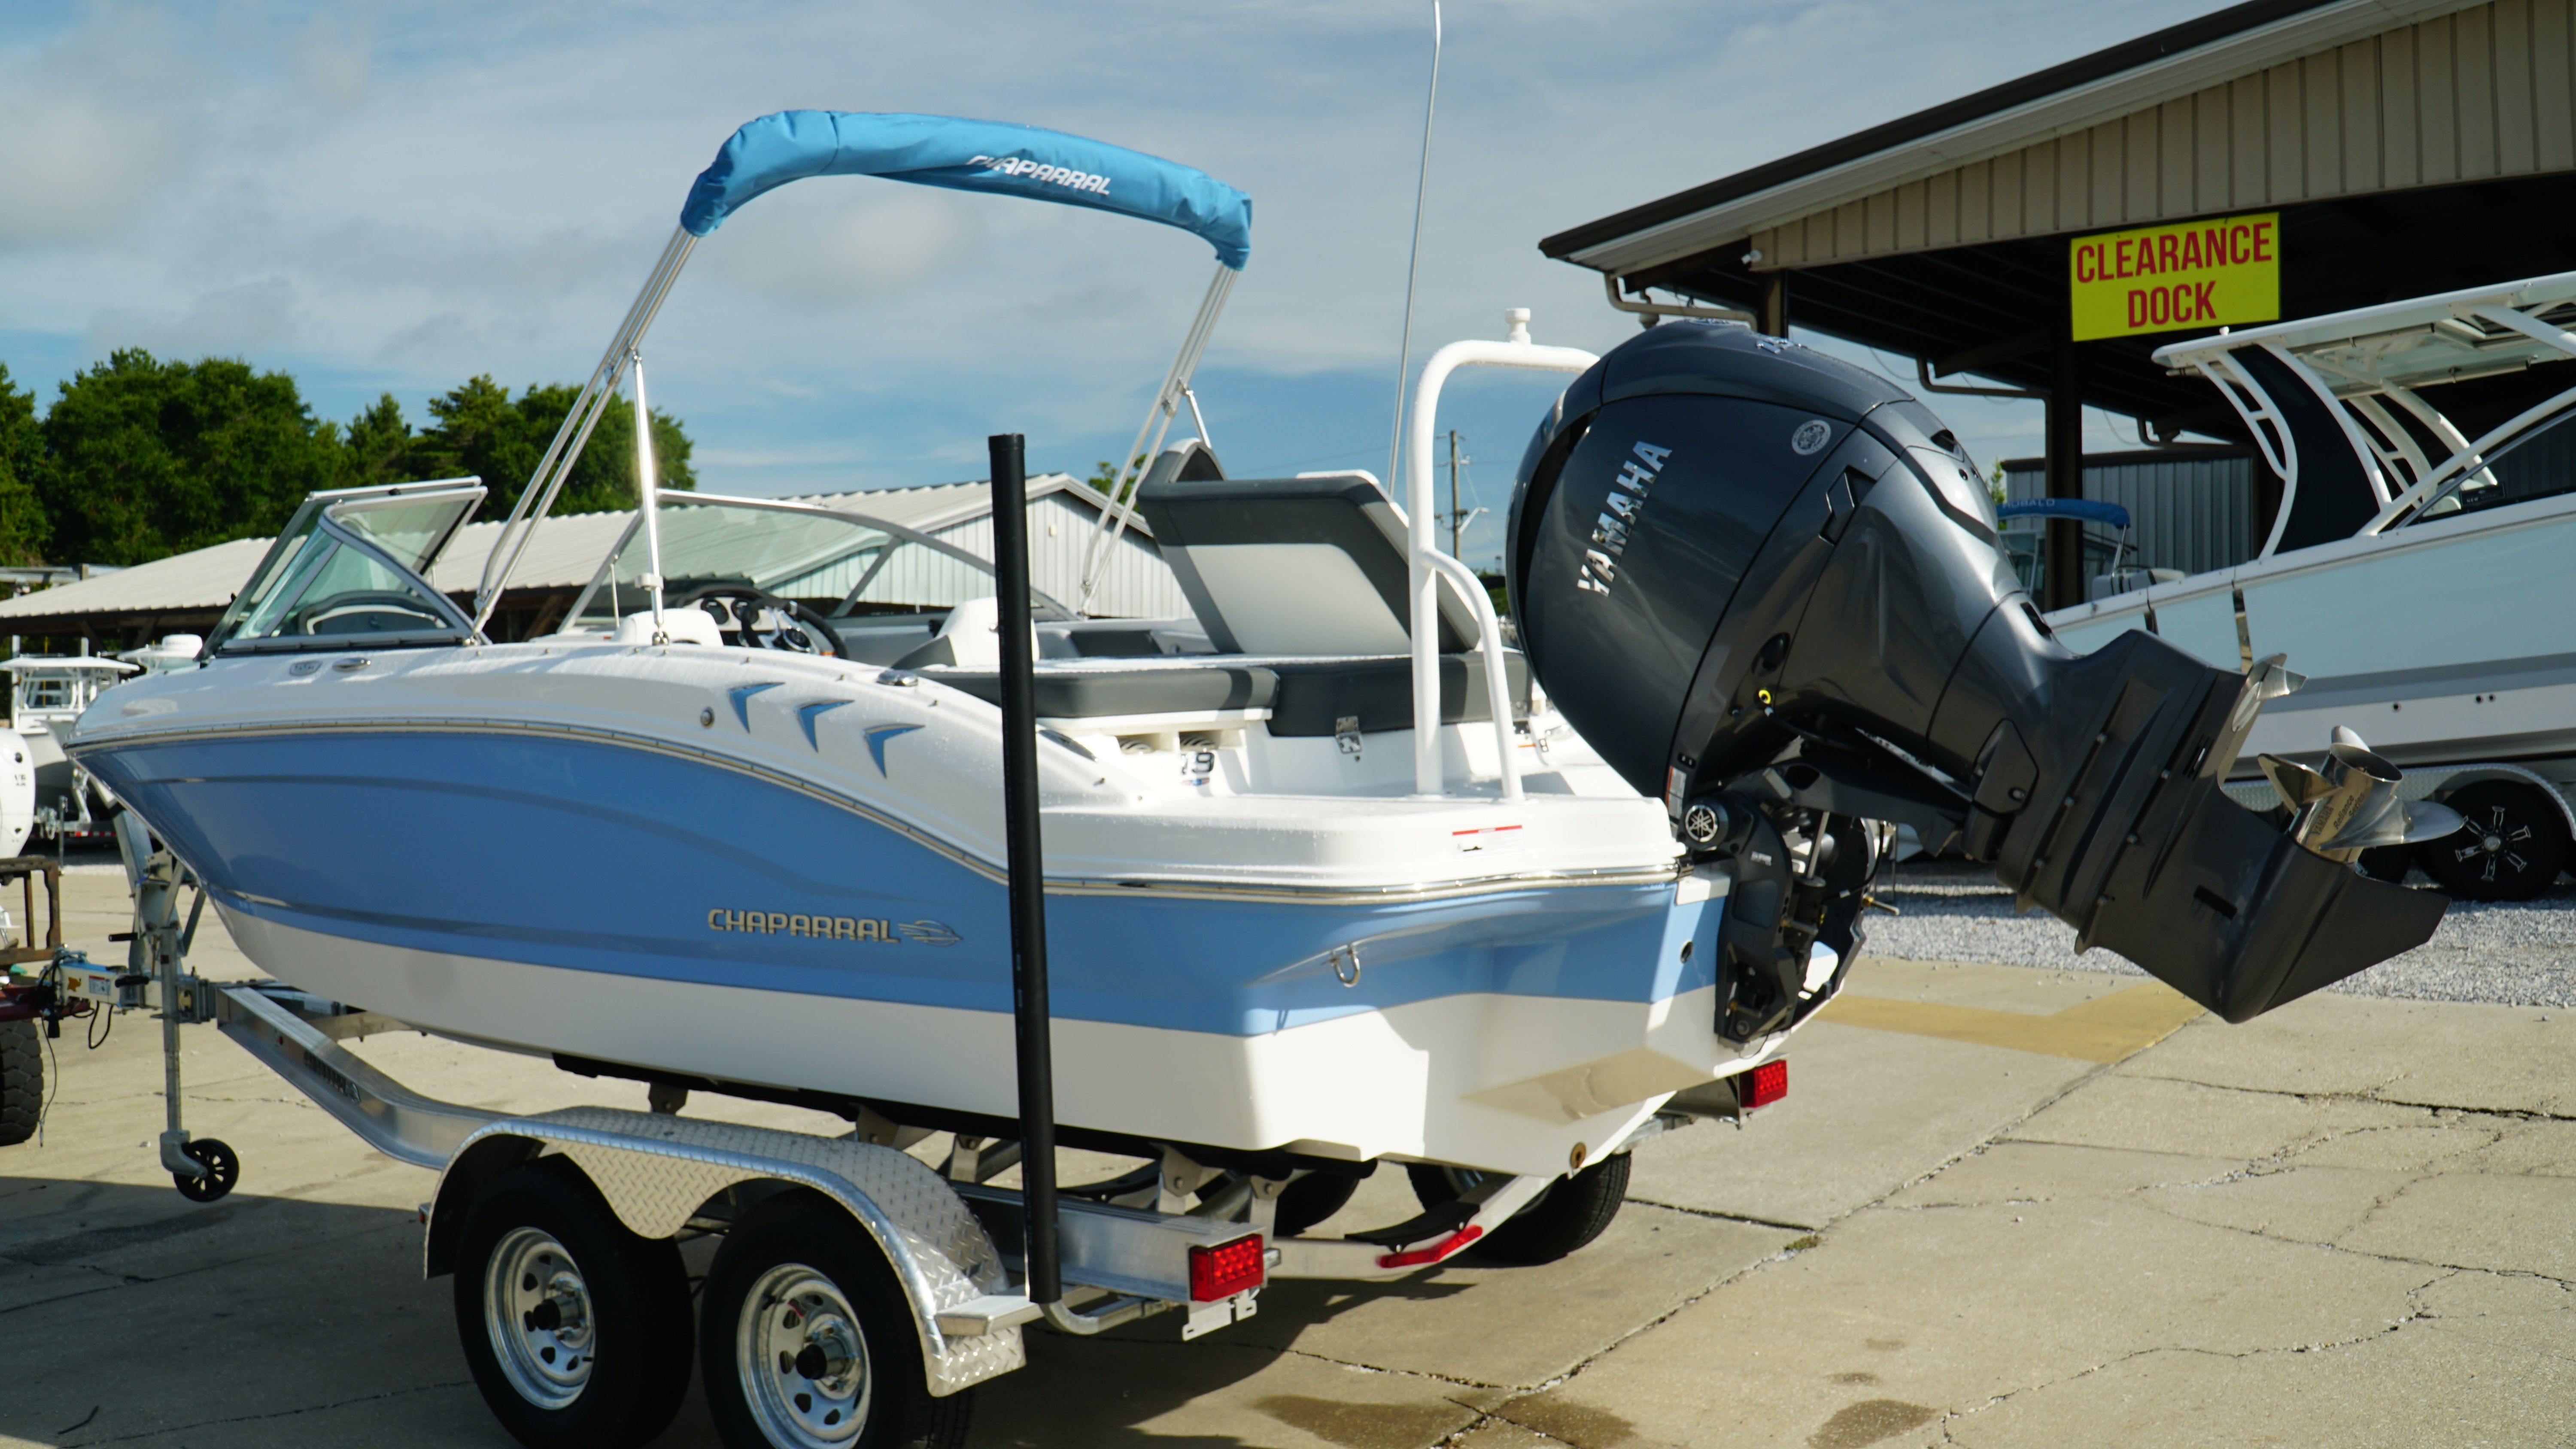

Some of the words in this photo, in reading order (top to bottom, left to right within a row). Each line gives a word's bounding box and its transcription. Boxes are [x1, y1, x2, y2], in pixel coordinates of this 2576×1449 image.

[2077, 222, 2272, 284] CLEARANCE
[2128, 280, 2217, 328] DOCK
[1577, 440, 1673, 597] YAMAHA
[2312, 805, 2334, 835] YAMAHA
[2334, 794, 2354, 830] Reliance
[2348, 792, 2365, 818] Series
[708, 908, 901, 943] CHAPARRAL
